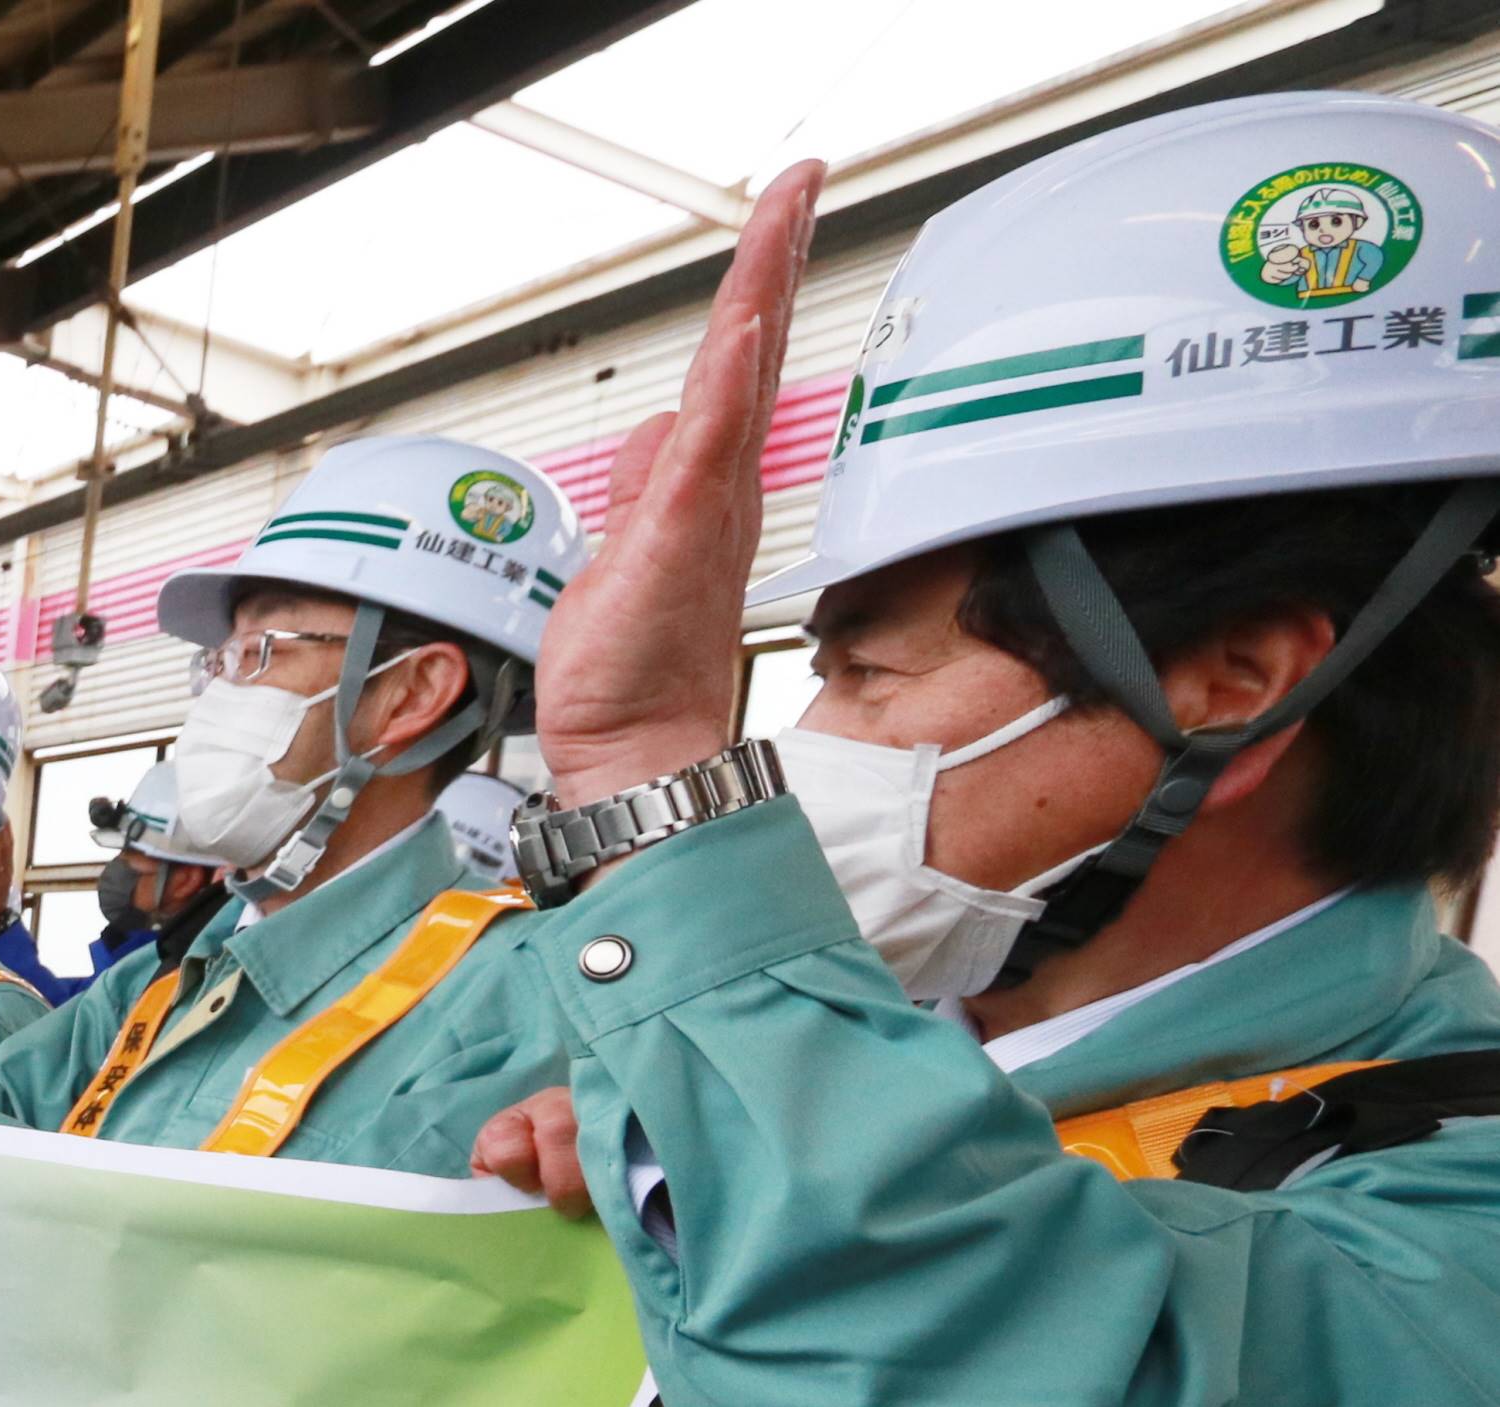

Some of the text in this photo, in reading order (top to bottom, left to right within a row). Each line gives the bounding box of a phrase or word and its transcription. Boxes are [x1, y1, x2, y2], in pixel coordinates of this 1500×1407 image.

[1164, 307, 1447, 379] 仙建工業
[415, 527, 530, 585] 仙建工業
